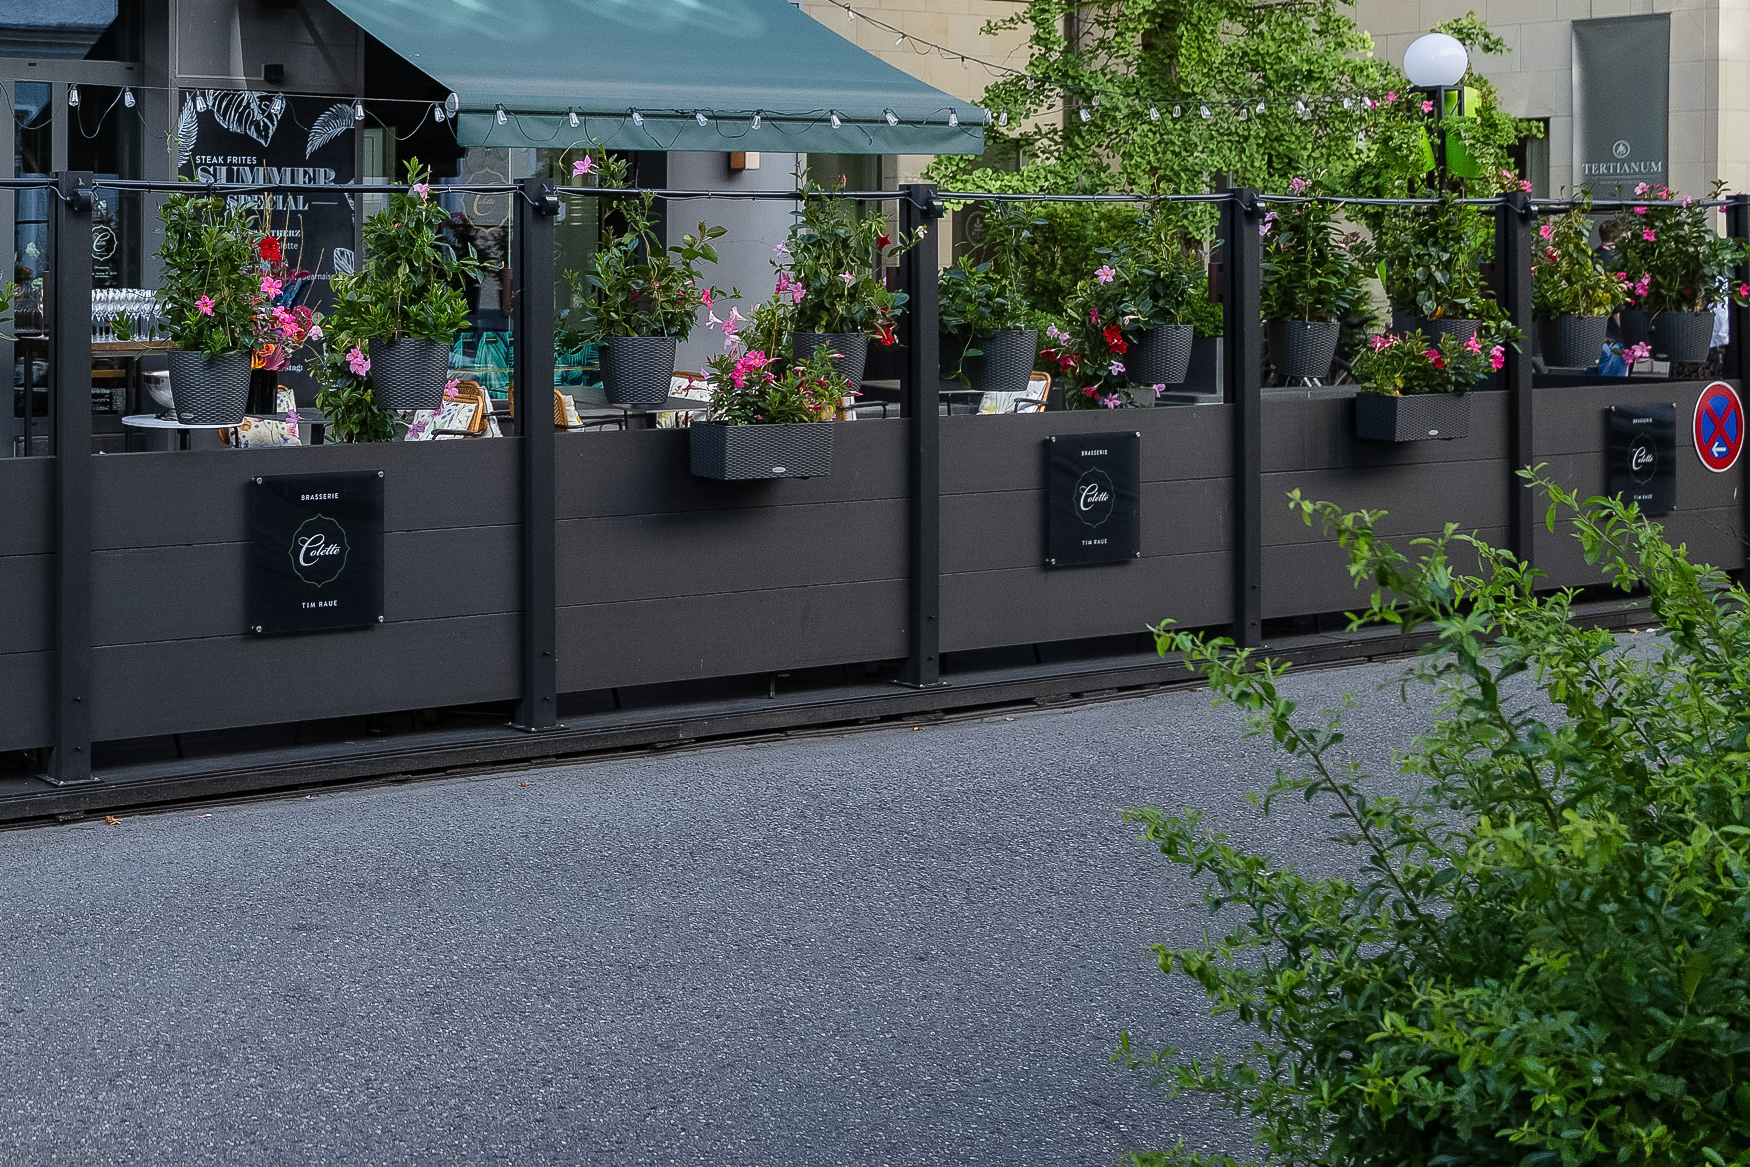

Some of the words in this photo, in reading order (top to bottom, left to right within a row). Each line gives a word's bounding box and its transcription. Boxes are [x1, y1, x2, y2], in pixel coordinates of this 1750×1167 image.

[195, 155, 224, 164] STEAK
[227, 155, 257, 165] FRITES
[1581, 160, 1663, 175] TERTIANUM
[196, 165, 336, 185] SUMMER
[225, 194, 309, 211] SPECIAL
[300, 492, 339, 501] BRASSERIE
[1079, 483, 1109, 511] Colette
[297, 533, 341, 567] Colette
[301, 601, 316, 609] TIM
[318, 599, 338, 608] RAUE
